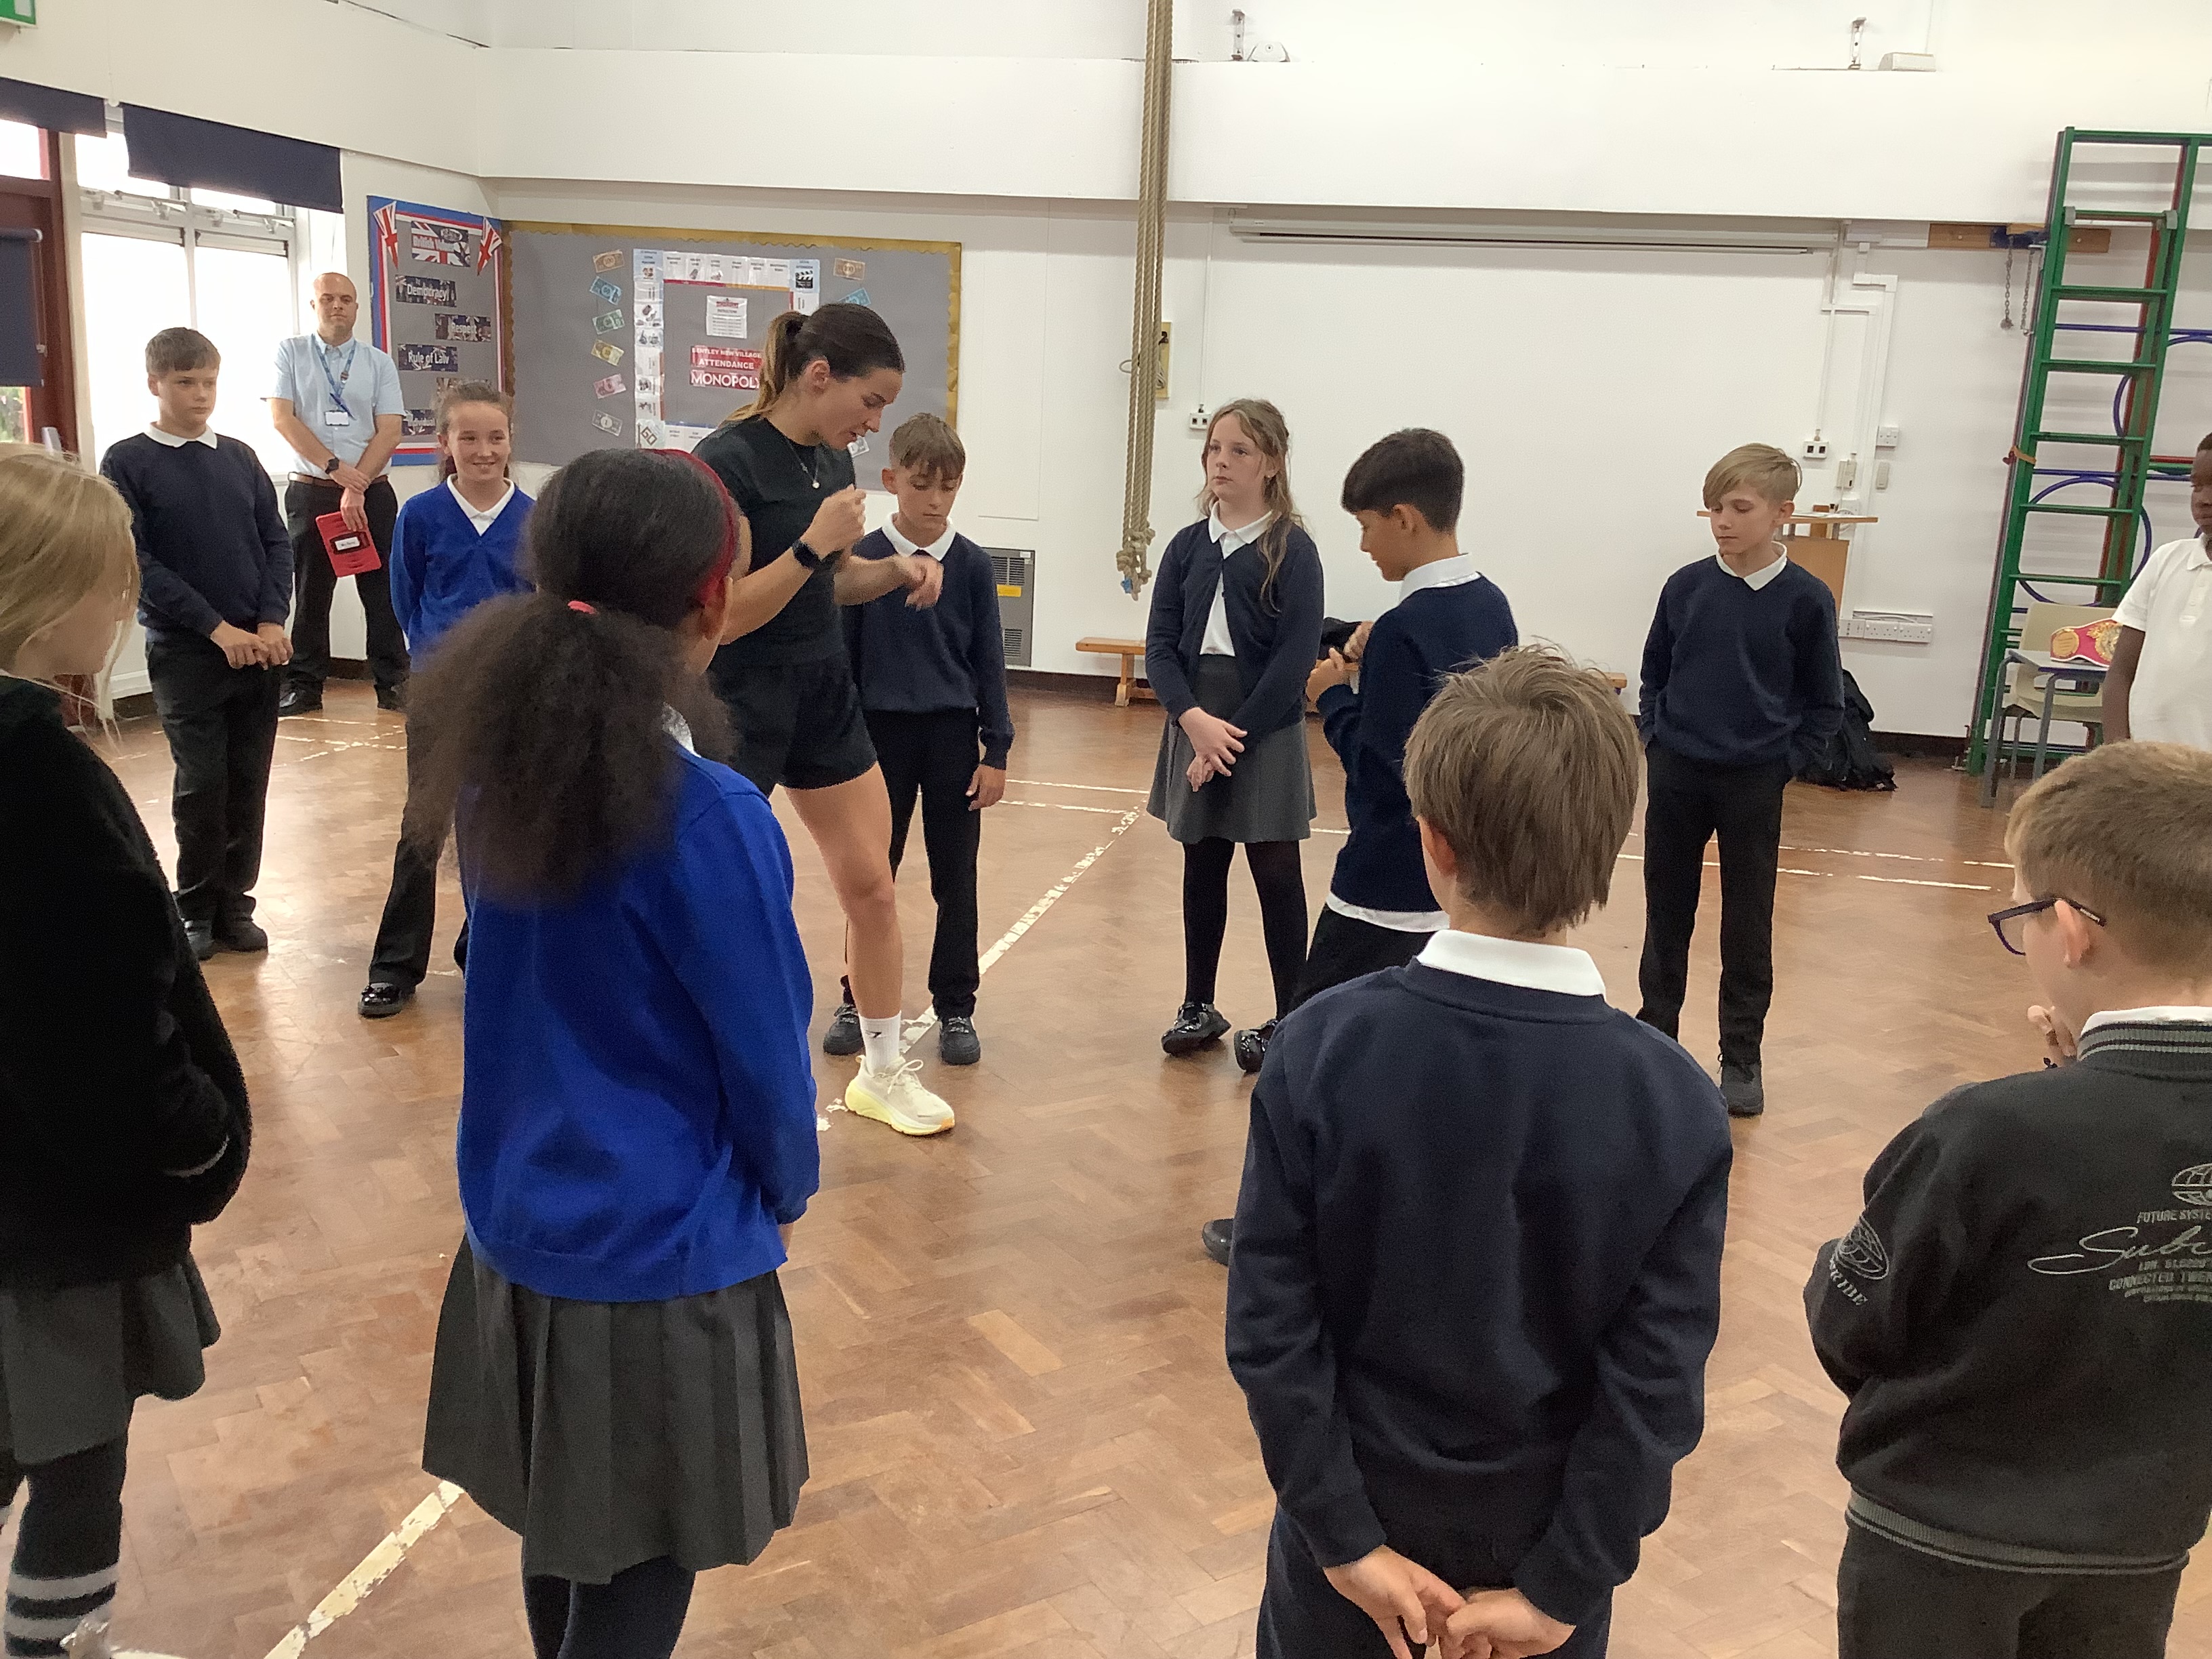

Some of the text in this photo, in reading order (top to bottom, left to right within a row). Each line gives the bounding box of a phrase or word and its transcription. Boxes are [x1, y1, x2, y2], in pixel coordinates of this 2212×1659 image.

[451, 323, 477, 337] Respect
[408, 352, 449, 365] Rule of Law
[699, 359, 754, 369] ATTENDANCE
[640, 426, 658, 446] GO
[2137, 1210, 2177, 1223] FUTURE
